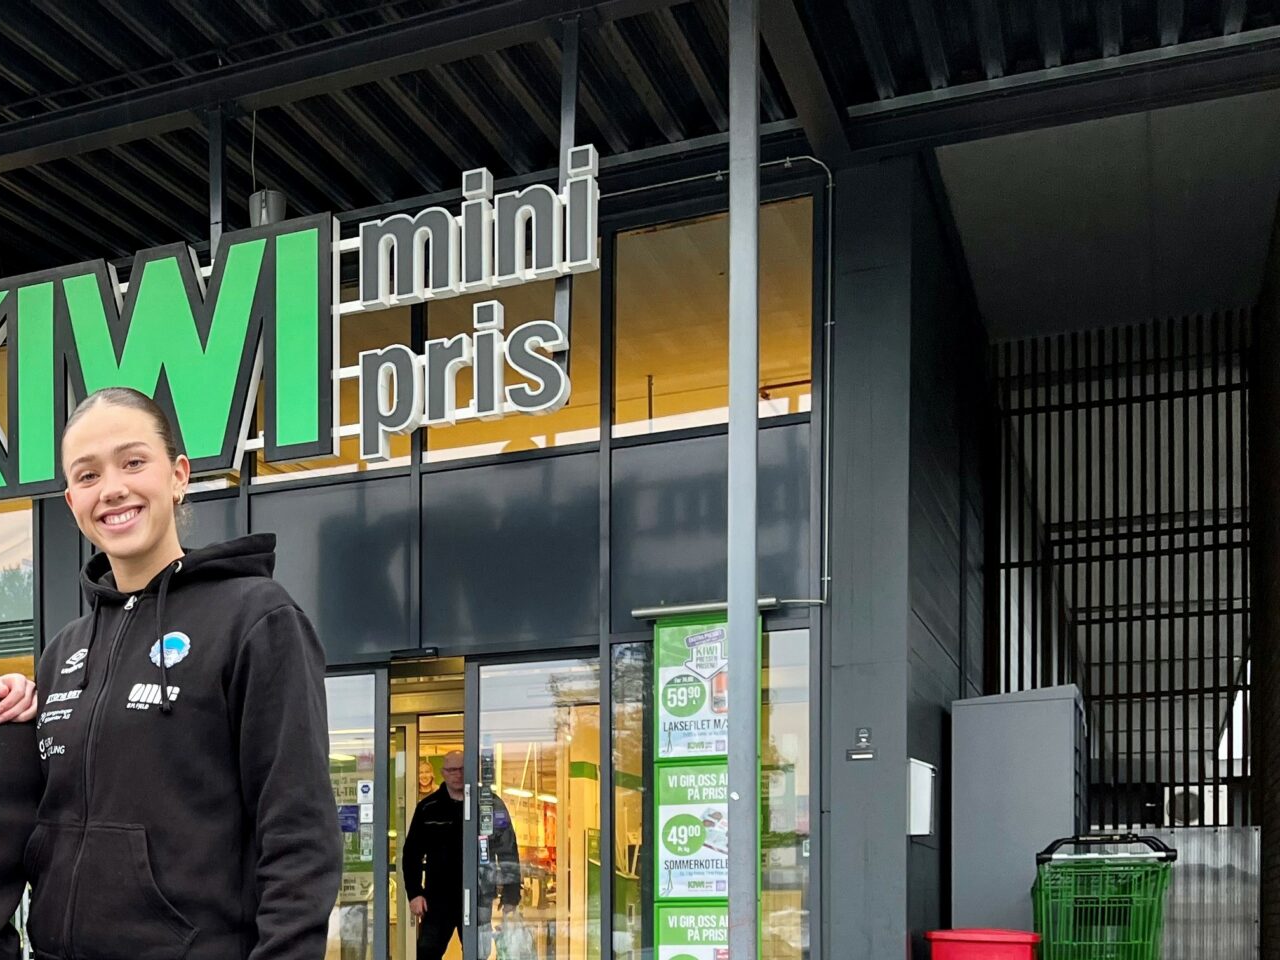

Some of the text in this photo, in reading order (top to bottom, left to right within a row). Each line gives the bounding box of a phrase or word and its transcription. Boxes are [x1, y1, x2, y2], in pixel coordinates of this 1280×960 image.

[359, 143, 600, 311] mini
[358, 299, 572, 462] pris
[663, 720, 711, 732] LAKSEFILET
[668, 775, 677, 788] VI
[680, 775, 695, 788] GIR
[698, 774, 717, 787] OSS
[702, 787, 728, 800] PRIS!
[668, 915, 677, 928] VI
[680, 915, 695, 928] GIR
[698, 915, 717, 928] OSS
[702, 928, 728, 941] PRIS!
